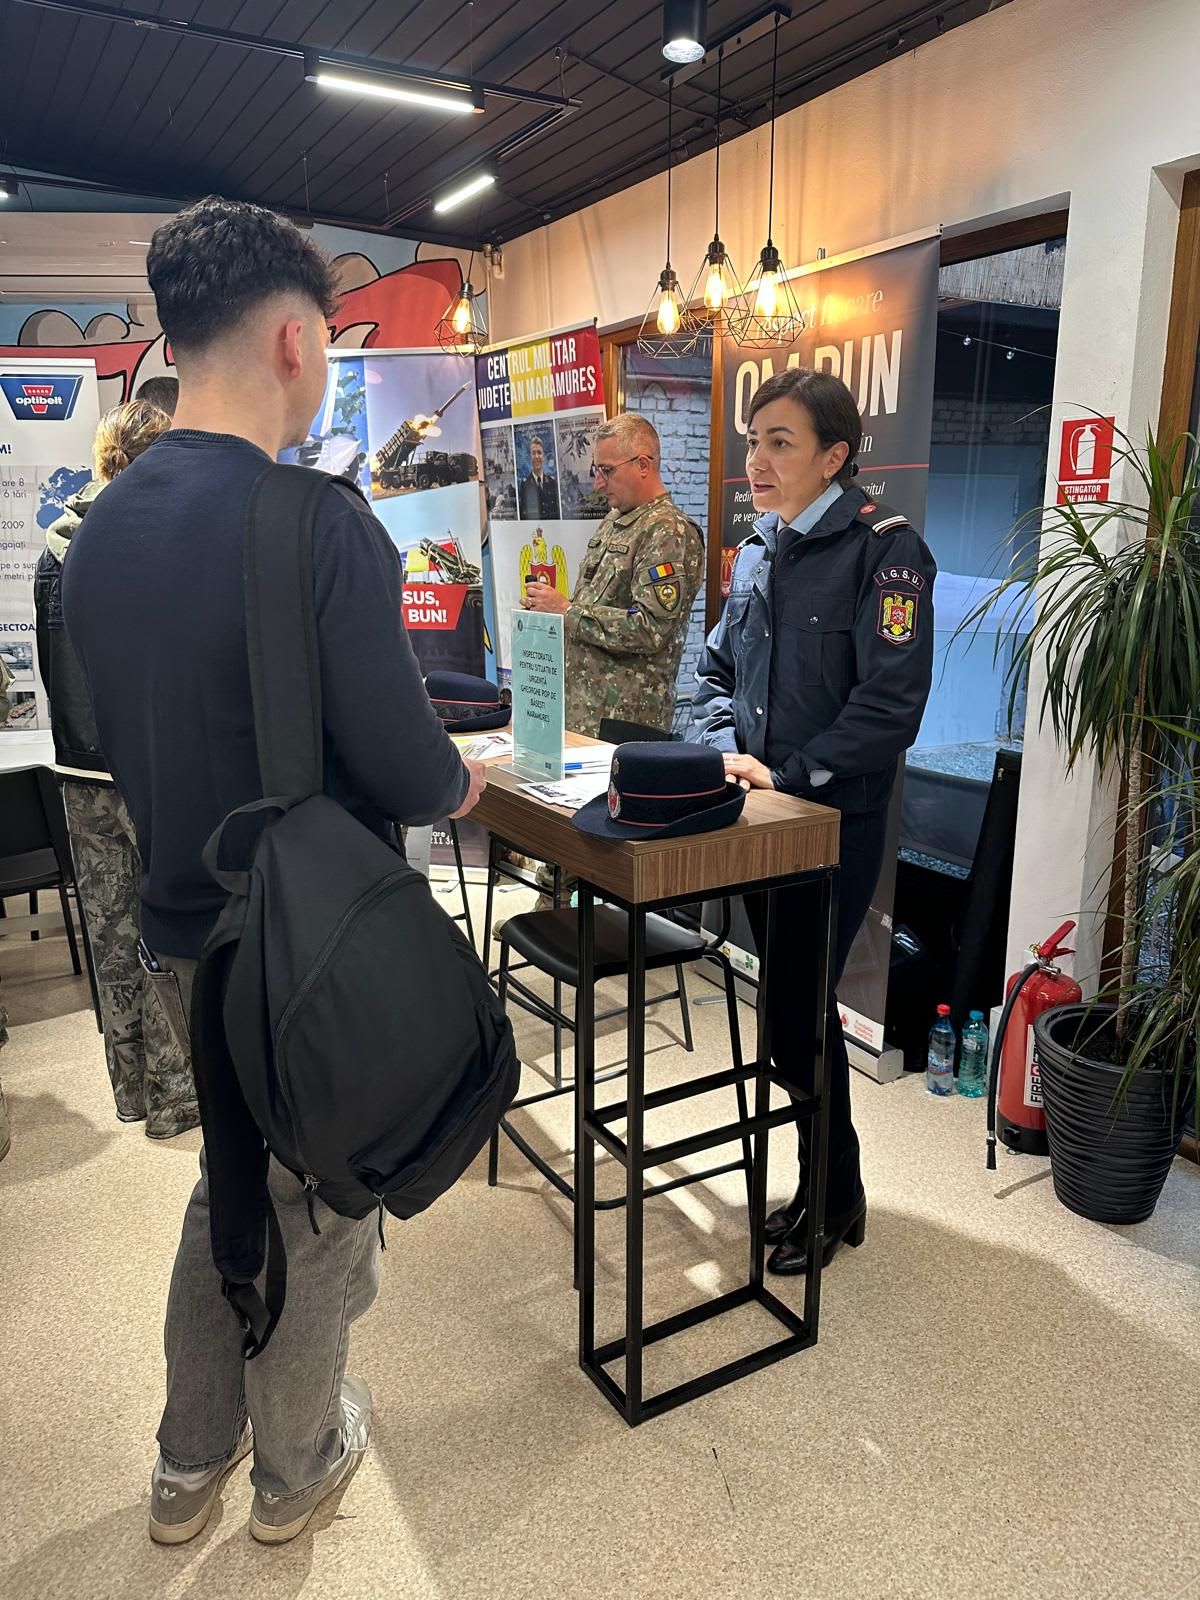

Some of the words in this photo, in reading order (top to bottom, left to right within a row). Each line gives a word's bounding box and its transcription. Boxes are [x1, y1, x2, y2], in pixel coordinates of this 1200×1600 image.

[487, 349, 531, 380] CENTRUL
[533, 338, 576, 370] MILITAR
[527, 365, 597, 400] MARAMUREȘ
[15, 396, 62, 406] optibelt
[19, 478, 25, 487] 8
[4, 489, 10, 498] 6
[1064, 485, 1102, 494] STINGATOR
[1067, 495, 1076, 503] DE
[1077, 494, 1097, 503] MANA
[732, 513, 742, 525] pe
[1, 520, 25, 530] 2009
[1, 563, 11, 571] pe
[5, 572, 25, 580] metri
[402, 590, 440, 607] SUS,
[408, 608, 447, 623] BUN!
[519, 660, 534, 671] PENTRU
[551, 667, 558, 676] DE
[541, 689, 550, 698] POP
[550, 691, 557, 700] DE
